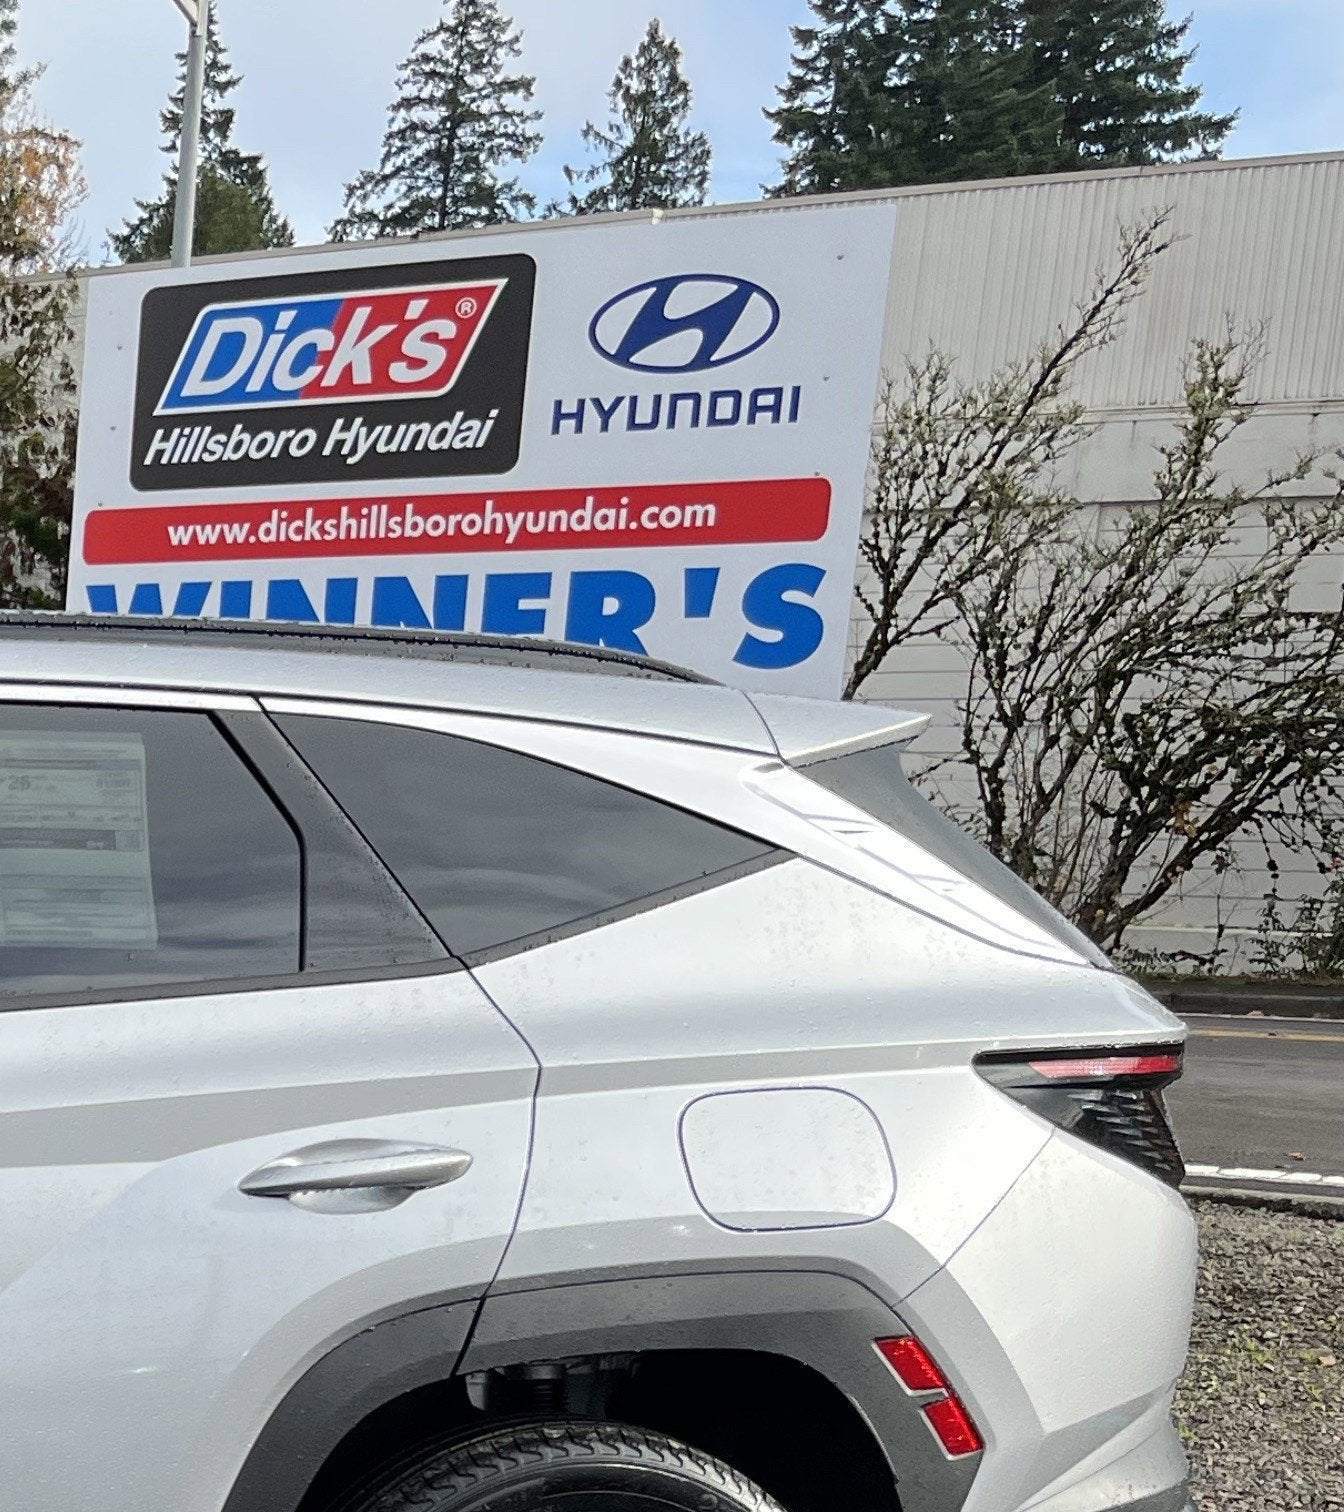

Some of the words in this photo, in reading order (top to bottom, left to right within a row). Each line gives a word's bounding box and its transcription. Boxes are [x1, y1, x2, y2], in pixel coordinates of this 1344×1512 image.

[180, 299, 458, 397] Dick's
[143, 423, 317, 466] Hillsboro
[322, 408, 499, 465] Hyundai
[550, 385, 801, 436] HYUNDAI
[167, 495, 716, 546] www.dickshillsborohyundai.com
